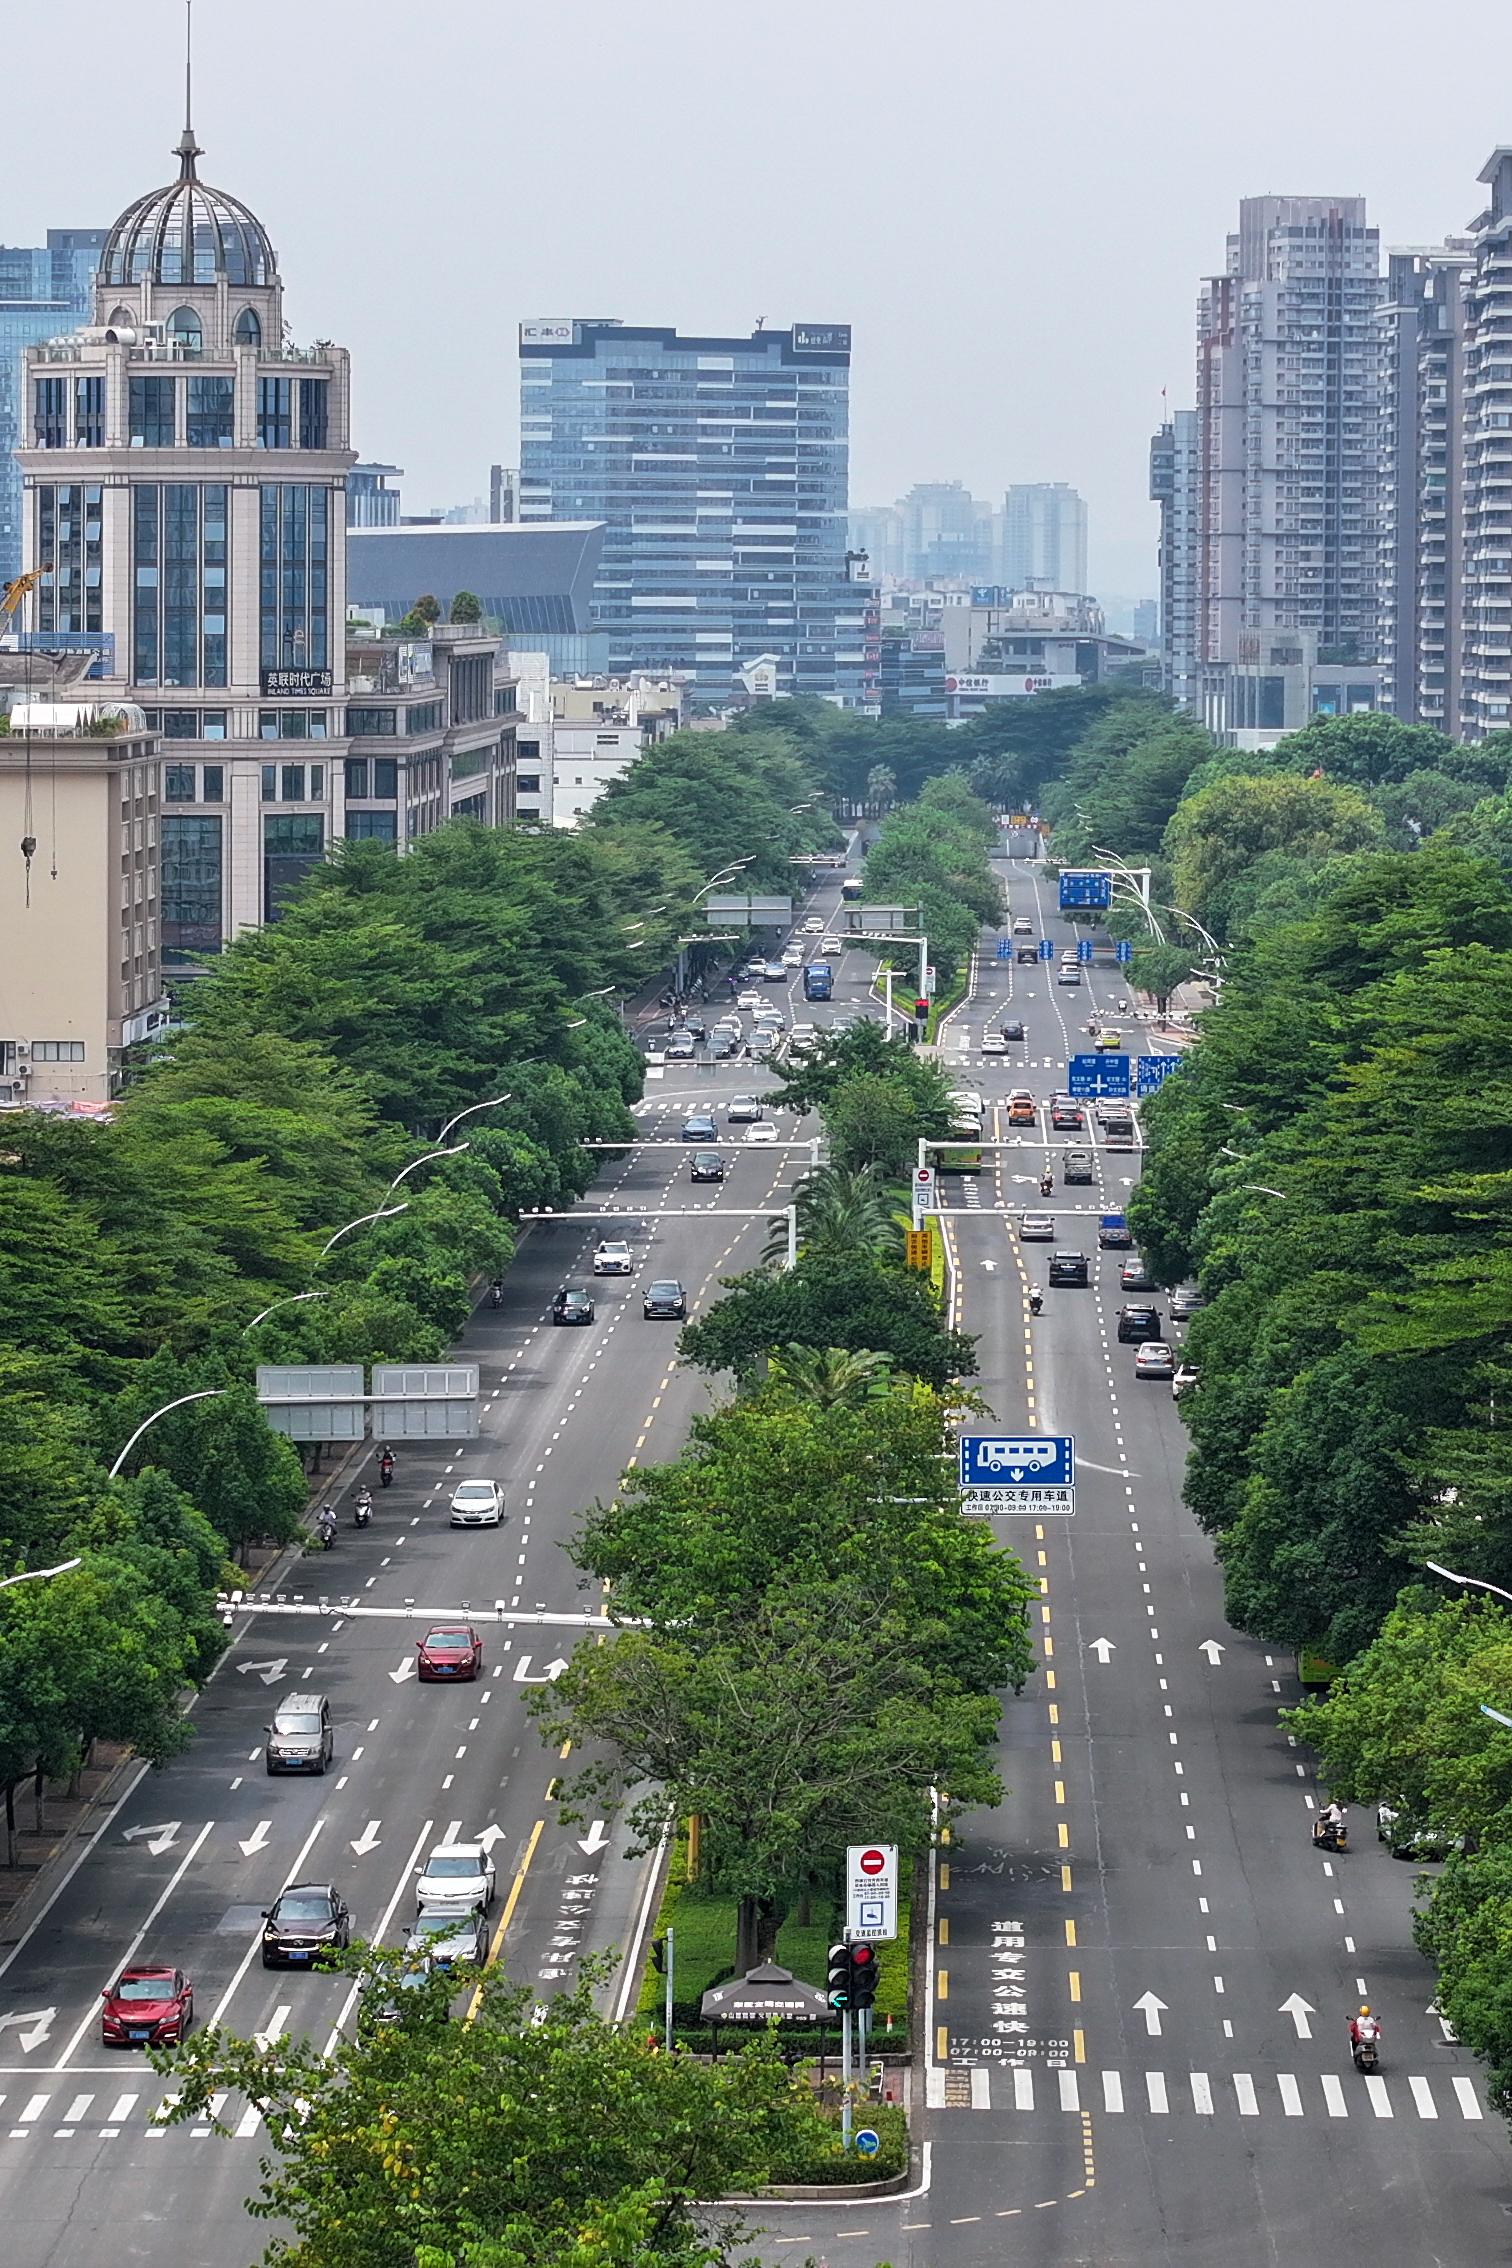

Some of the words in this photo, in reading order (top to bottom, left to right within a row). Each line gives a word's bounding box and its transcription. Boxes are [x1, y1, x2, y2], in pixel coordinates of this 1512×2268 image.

[969, 1490, 1068, 1502] 快速公交专用车道
